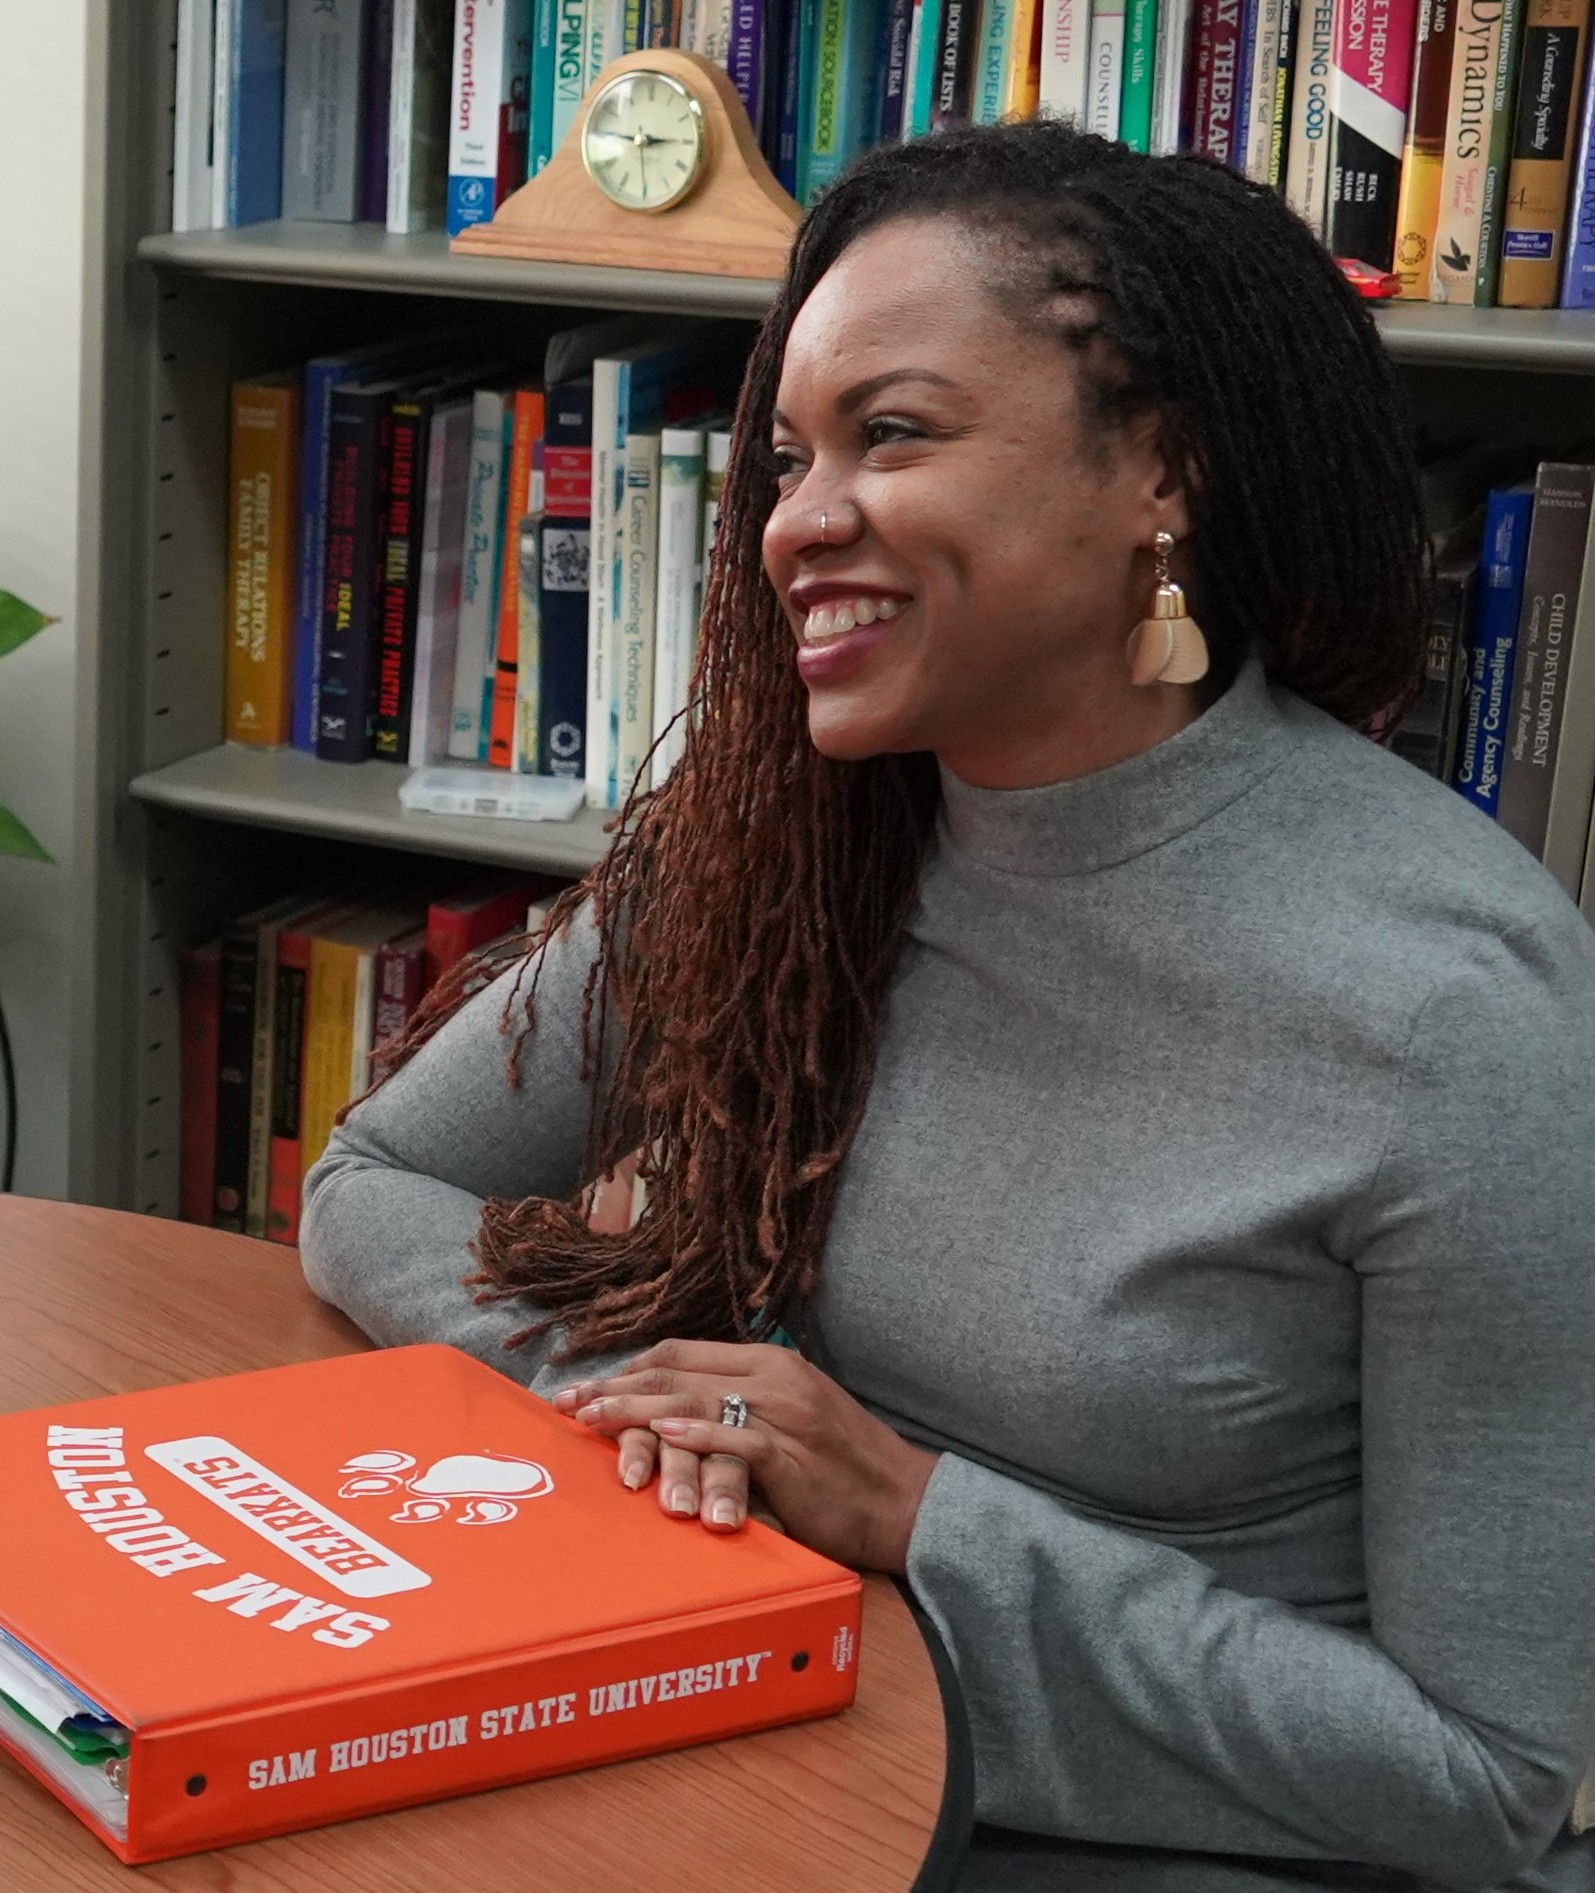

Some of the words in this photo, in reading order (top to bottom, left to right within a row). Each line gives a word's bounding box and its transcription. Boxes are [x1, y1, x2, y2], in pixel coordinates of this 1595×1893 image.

[945, 2, 962, 46] BOOK
[989, 0, 1007, 38] ING
[1132, 0, 1147, 43] herapy
[1265, 0, 1278, 23] IBS
[1419, 0, 1432, 42] RDERS
[1434, 6, 1447, 33] AND
[943, 48, 958, 70] OF
[1264, 31, 1276, 44] In
[1367, 13, 1388, 92] THERAPY
[1547, 32, 1561, 44] A
[940, 71, 956, 112] LISTS
[1131, 48, 1145, 84] Skills
[1260, 48, 1275, 84] Search
[1456, 0, 1503, 159] Dynamics
[1536, 45, 1559, 103] Counseling
[1207, 38, 1237, 164] THERAP
[1256, 102, 1269, 124] Self
[1258, 88, 1271, 99] of
[1273, 66, 1287, 122] JONATHAN
[1305, 83, 1327, 140] GOOD
[1343, 170, 1355, 202] SHAW
[1355, 172, 1367, 202] RUSH
[1367, 173, 1379, 202] BECK
[238, 477, 255, 549] FAMILY
[255, 472, 272, 545] OBJECT
[629, 496, 648, 546] Career
[384, 539, 410, 582] IDEAL
[234, 553, 252, 652] THERAPY
[250, 551, 271, 662] RELATIONS
[335, 582, 354, 630] IDEAL
[382, 586, 408, 646] PRIVATE
[626, 550, 645, 635] Counseling
[1547, 593, 1567, 645] CHILD
[377, 649, 404, 717] PRACTICE
[625, 640, 643, 723] Techniques
[1472, 647, 1487, 681] and
[1484, 636, 1513, 731] Counseling
[1520, 689, 1535, 710] and
[1532, 648, 1561, 768] DEVELOPMENT
[1458, 684, 1487, 783] Community
[1476, 732, 1500, 798] Agency
[46, 1425, 227, 1578] HOUSTON
[183, 1455, 391, 1577] BEARKATS
[191, 1572, 391, 1649] SAM
[835, 1626, 849, 1672] Recycled
[249, 1750, 316, 1790] SAM
[330, 1716, 468, 1773] HOUSTON
[480, 1694, 576, 1740] STATE
